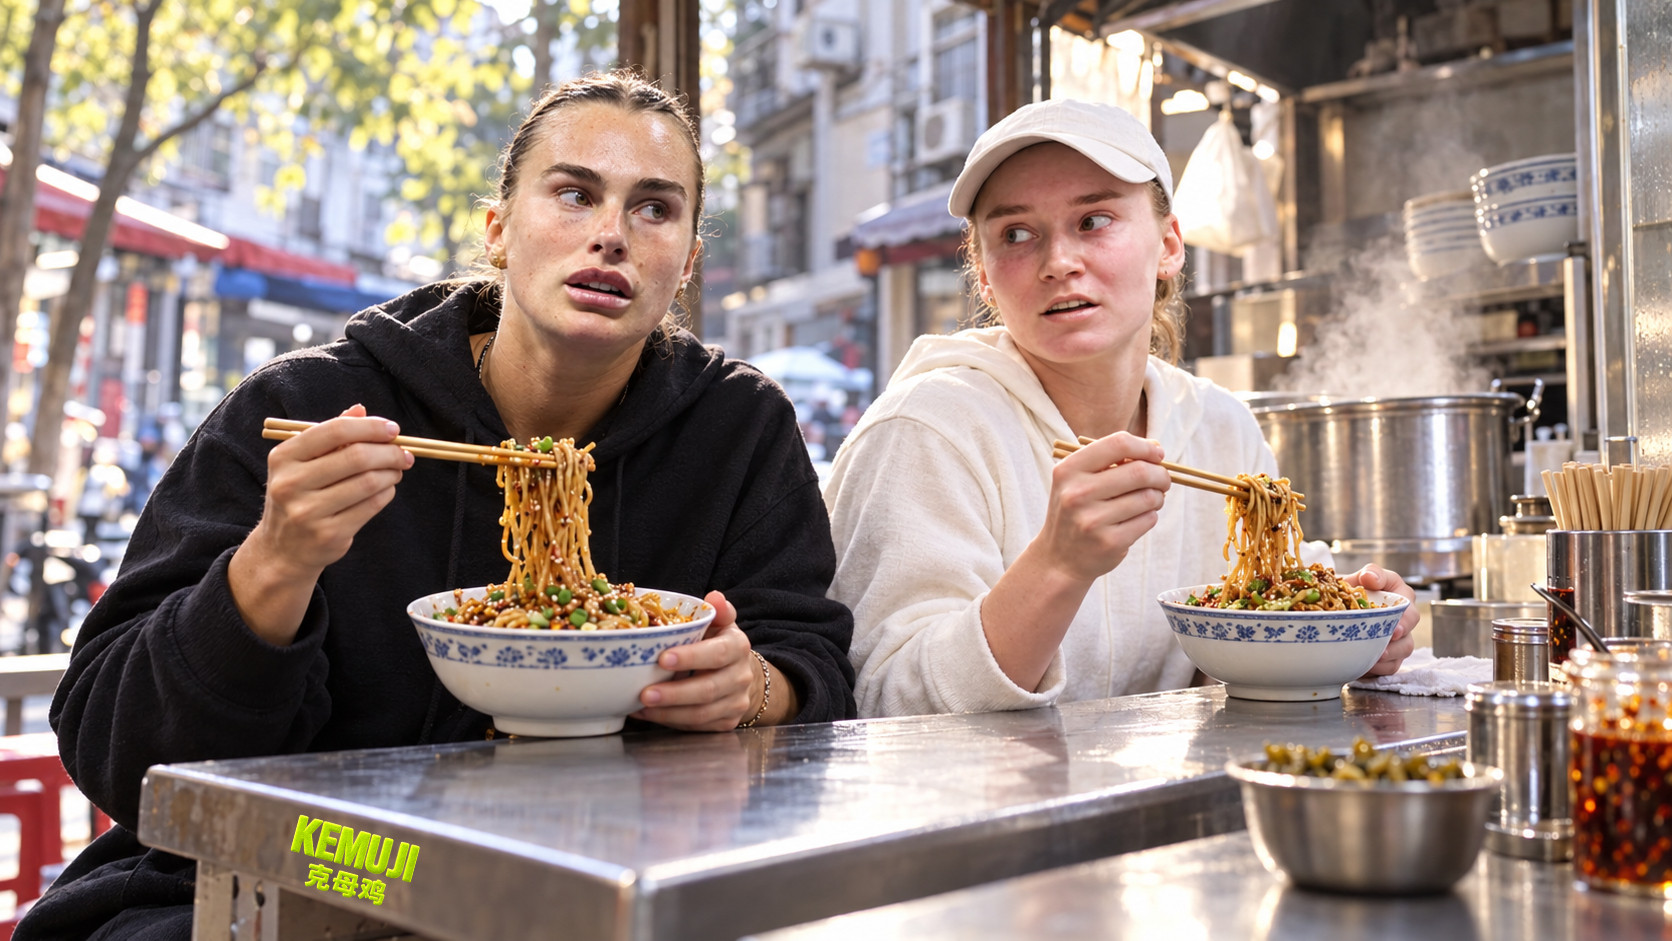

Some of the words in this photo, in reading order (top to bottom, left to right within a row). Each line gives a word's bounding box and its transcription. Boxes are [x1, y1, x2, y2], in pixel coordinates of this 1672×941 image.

[290, 814, 421, 883] KEMUJI
[304, 863, 387, 906] 克母鸡
